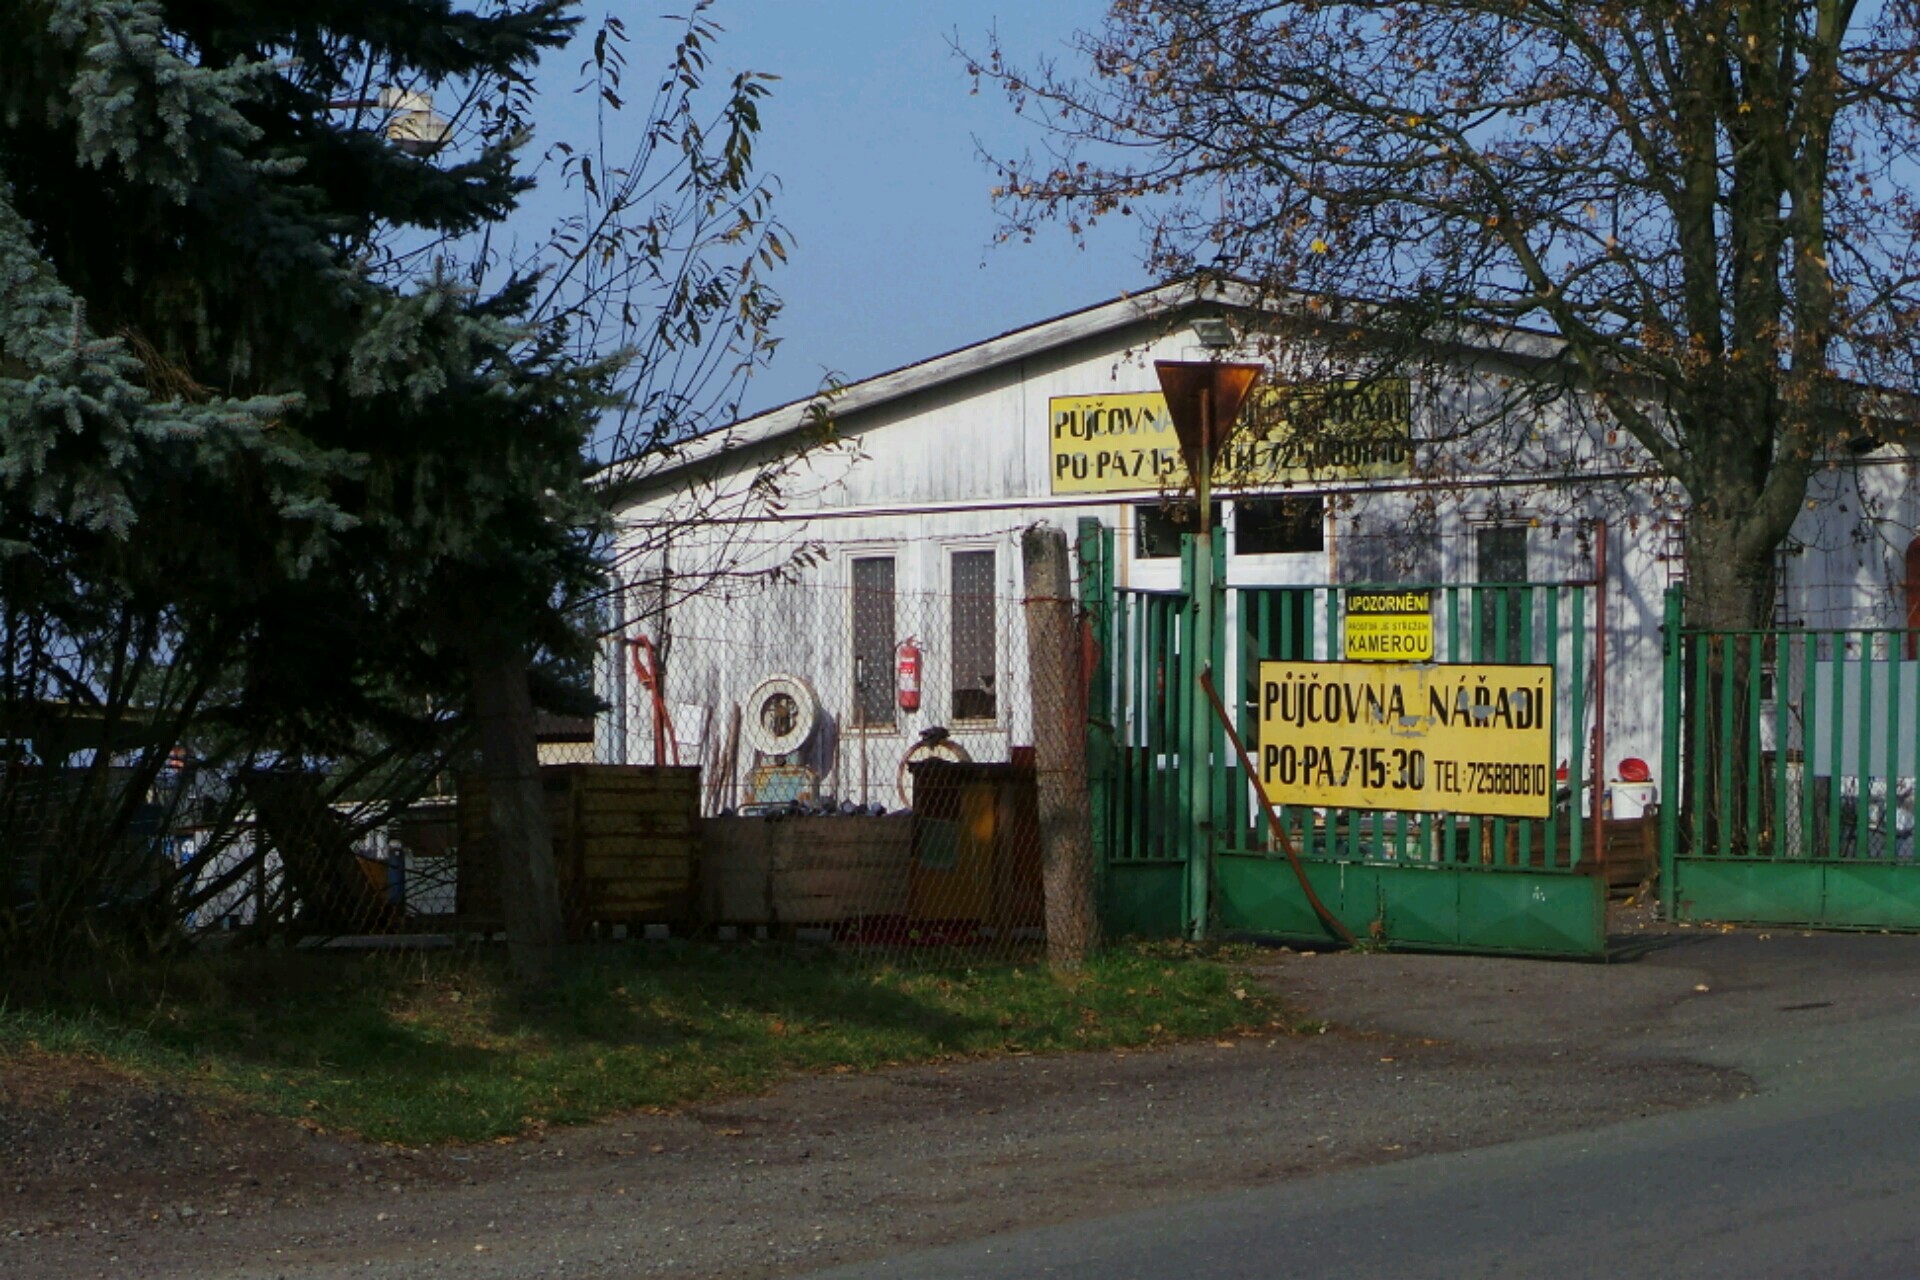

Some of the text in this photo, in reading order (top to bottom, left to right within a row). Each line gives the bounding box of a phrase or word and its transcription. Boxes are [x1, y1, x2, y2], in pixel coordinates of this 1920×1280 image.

[1348, 592, 1429, 611] UPOZORNĚNÍ
[1348, 634, 1427, 653] KAMEROU
[1264, 671, 1545, 730] PŮJČOVNA NÁŘADÍ
